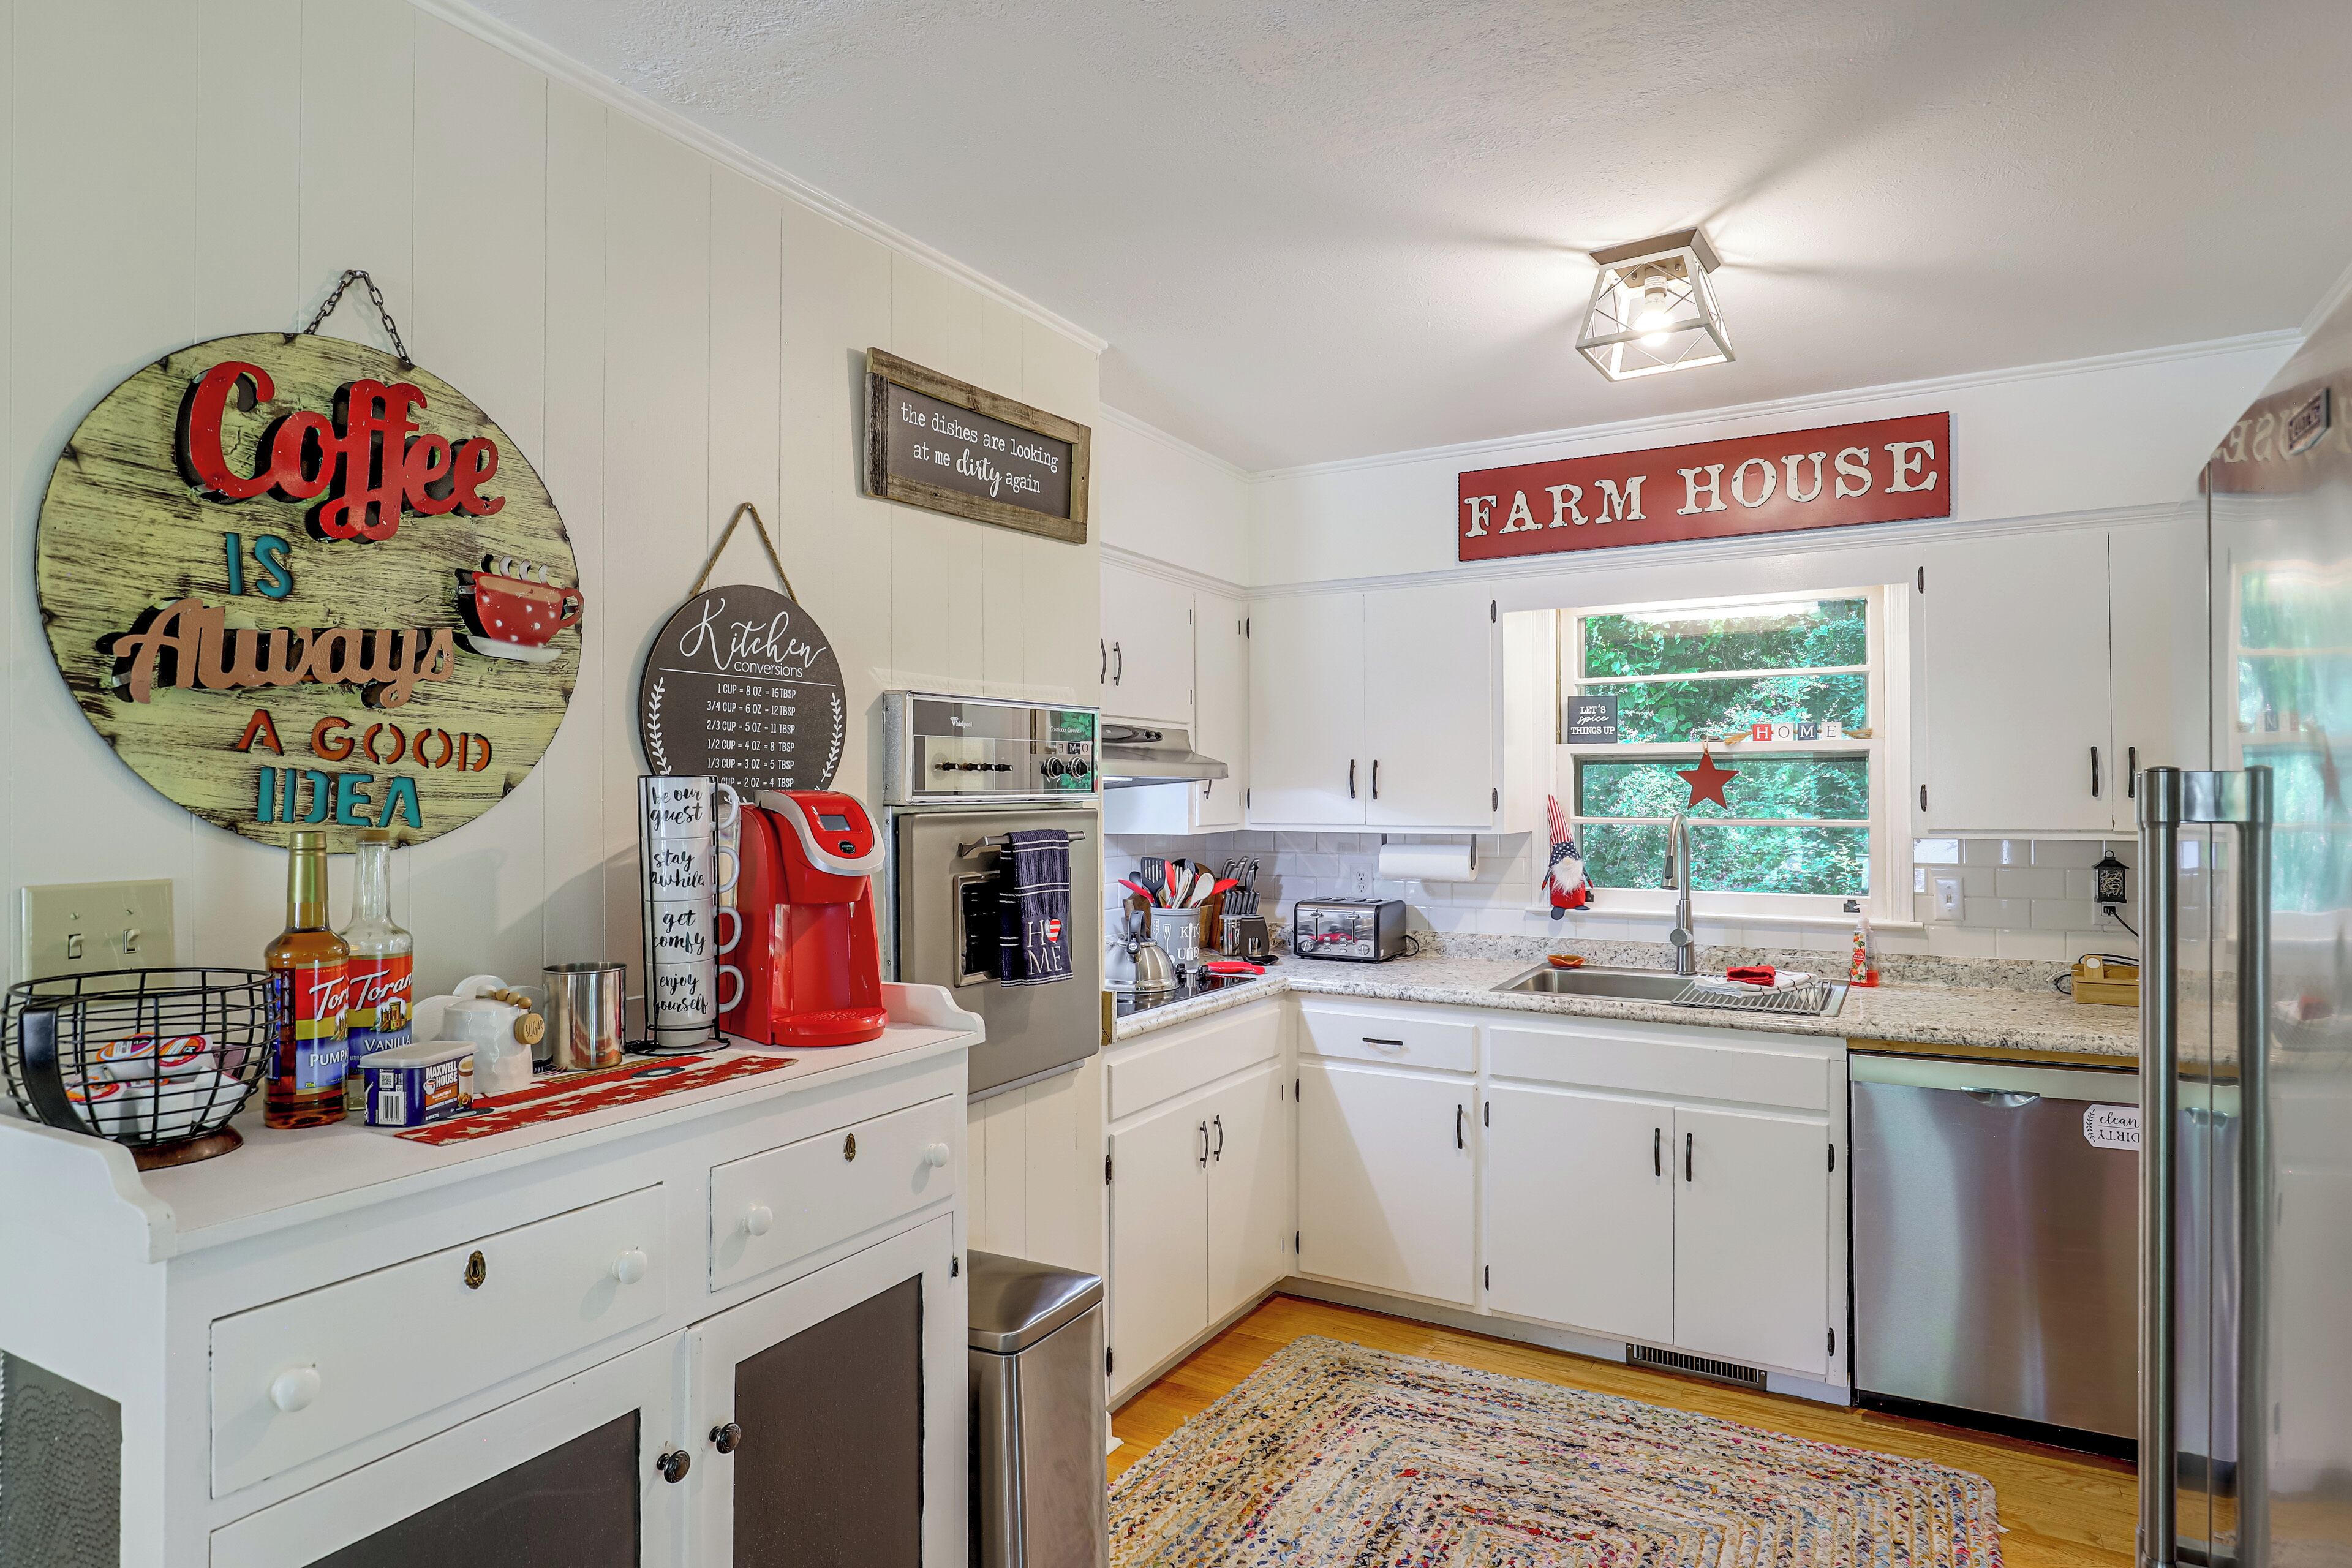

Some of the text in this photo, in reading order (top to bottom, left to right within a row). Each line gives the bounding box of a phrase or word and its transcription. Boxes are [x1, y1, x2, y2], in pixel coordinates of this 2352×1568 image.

[901, 402, 1058, 473] the dishes are looking
[190, 361, 505, 540] Coffee
[913, 442, 1041, 497] at me dirty again
[1464, 439, 1938, 538] FARM HOUSE
[225, 532, 292, 598] IS
[680, 598, 826, 670] Kitchen
[113, 598, 454, 707] Always
[734, 661, 802, 677] conversions
[718, 684, 721, 693] 1
[723, 684, 737, 695] CUP
[746, 686, 751, 695] 8
[753, 686, 761, 696] OZ
[772, 688, 779, 697] 16
[780, 688, 796, 699] TBSP
[707, 700, 720, 712] 3/4
[722, 702, 736, 712] CUP
[745, 704, 750, 713] 6
[753, 704, 761, 714] OZ
[771, 705, 778, 715] 12
[779, 706, 796, 717] TBSP
[1580, 704, 1606, 714] LET'S
[707, 720, 720, 730] 2/3
[722, 720, 736, 731] CUP
[745, 722, 750, 731] 5
[752, 722, 761, 732] OZ
[771, 723, 777, 733] 11
[778, 724, 795, 734] TBSP
[951, 720, 973, 729] Whirlpool
[1577, 715, 1610, 725] spice
[236, 709, 491, 772] A GOOD
[1756, 725, 1836, 739] HOME
[707, 739, 720, 750] 1/2
[722, 739, 736, 750] CUP
[745, 741, 750, 750] 4
[752, 741, 760, 751] OZ
[770, 742, 775, 752] 8
[778, 742, 794, 752] TBSP
[707, 758, 720, 768] 1/3
[722, 758, 735, 769] CUP
[745, 760, 749, 769] 3
[752, 760, 760, 769] OZ
[770, 760, 775, 769] 5
[778, 760, 794, 770] TBSP
[721, 778, 735, 788] CUP
[744, 778, 748, 787] 2
[751, 778, 760, 788] OZ
[769, 778, 774, 787] 4
[778, 778, 794, 788] TBSP
[256, 766, 423, 829] IDEA
[652, 786, 703, 805] be our
[650, 802, 703, 831] guest
[654, 848, 695, 872] stay
[651, 869, 705, 888] awhile
[663, 909, 696, 933] get
[652, 931, 706, 956] comfy
[1027, 946, 1063, 974] ME
[660, 973, 699, 995] enjoy
[655, 993, 709, 1020] yourself
[526, 1019, 544, 1038] SUGAR
[364, 1035, 411, 1052] VANILLA
[426, 1061, 458, 1080] MAXWELL
[436, 1071, 458, 1088] HOUSE
[2100, 1112, 2139, 1128] clean
[2098, 1129, 2139, 1143] DIRTY
